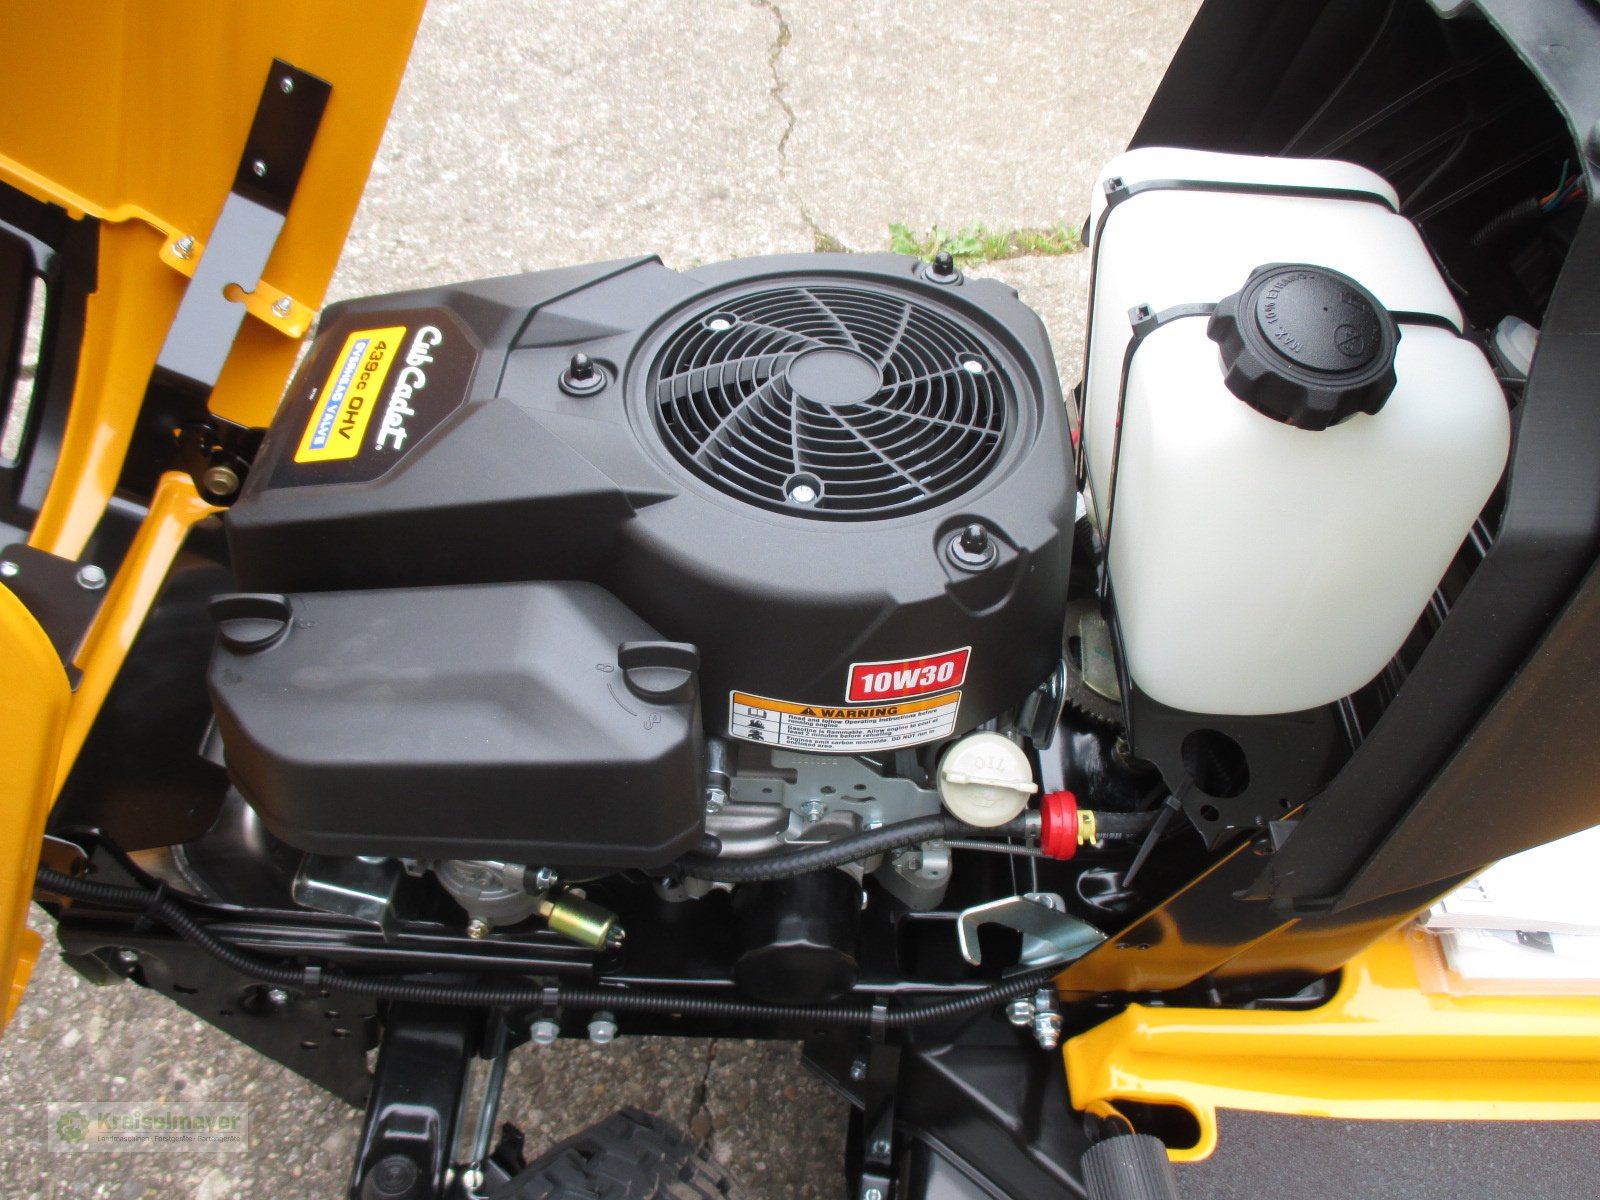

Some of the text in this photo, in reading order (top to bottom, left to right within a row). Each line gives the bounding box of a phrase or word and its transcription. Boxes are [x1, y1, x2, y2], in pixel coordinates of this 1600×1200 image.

[1264, 302, 1279, 325] 10%
[313, 340, 367, 445] OVERHEAD VALVE
[338, 340, 387, 440] 439cc OHV
[376, 325, 443, 450] Cub Cadet
[860, 660, 955, 694] 10W30
[821, 707, 898, 718] WARNING
[844, 717, 876, 725] Operating
[917, 708, 938, 717] before
[787, 725, 817, 733] Gasoline
[788, 719, 814, 727] running
[786, 735, 813, 744] Engines
[786, 740, 816, 748] enclosed
